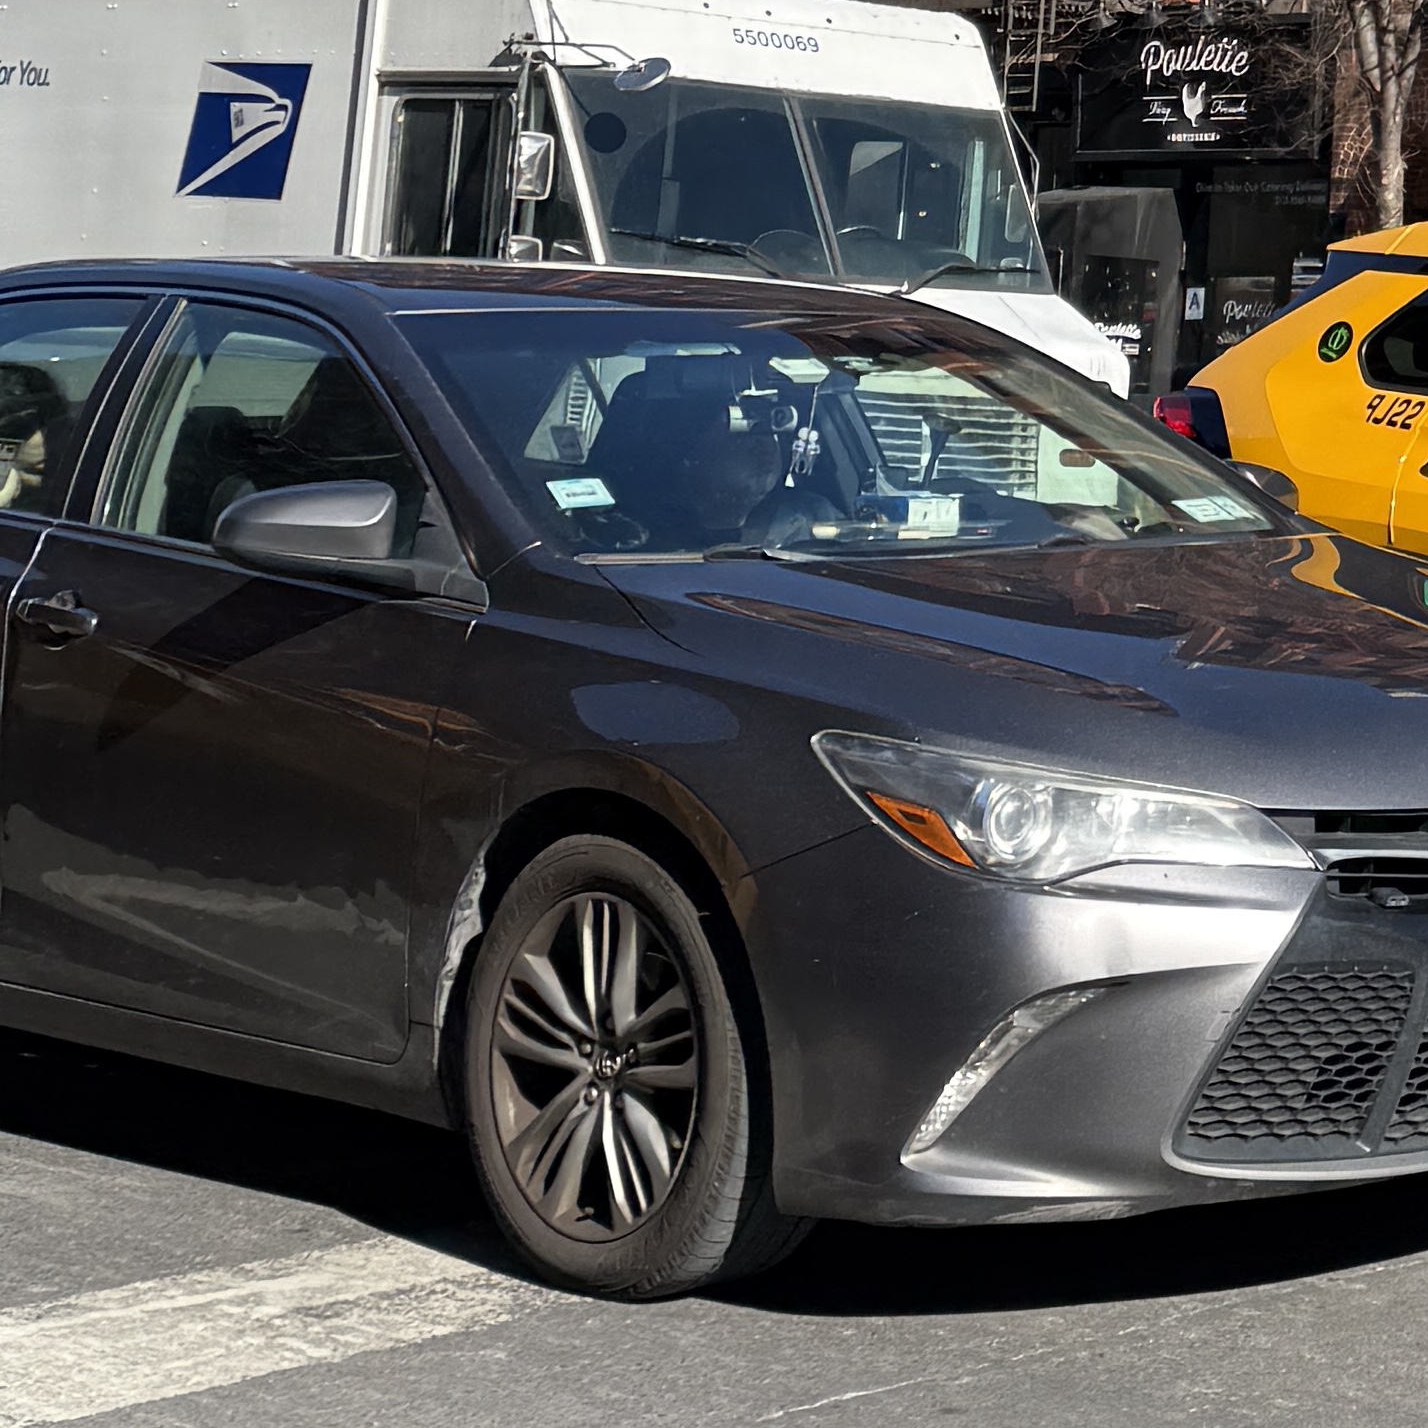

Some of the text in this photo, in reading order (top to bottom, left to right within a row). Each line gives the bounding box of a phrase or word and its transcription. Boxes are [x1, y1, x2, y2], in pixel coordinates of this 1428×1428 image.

[733, 28, 819, 52] 5500069
[0, 59, 50, 86] or You.
[1140, 35, 1250, 88] Poulette
[1188, 291, 1200, 310] A
[1366, 394, 1426, 431] 9J22
